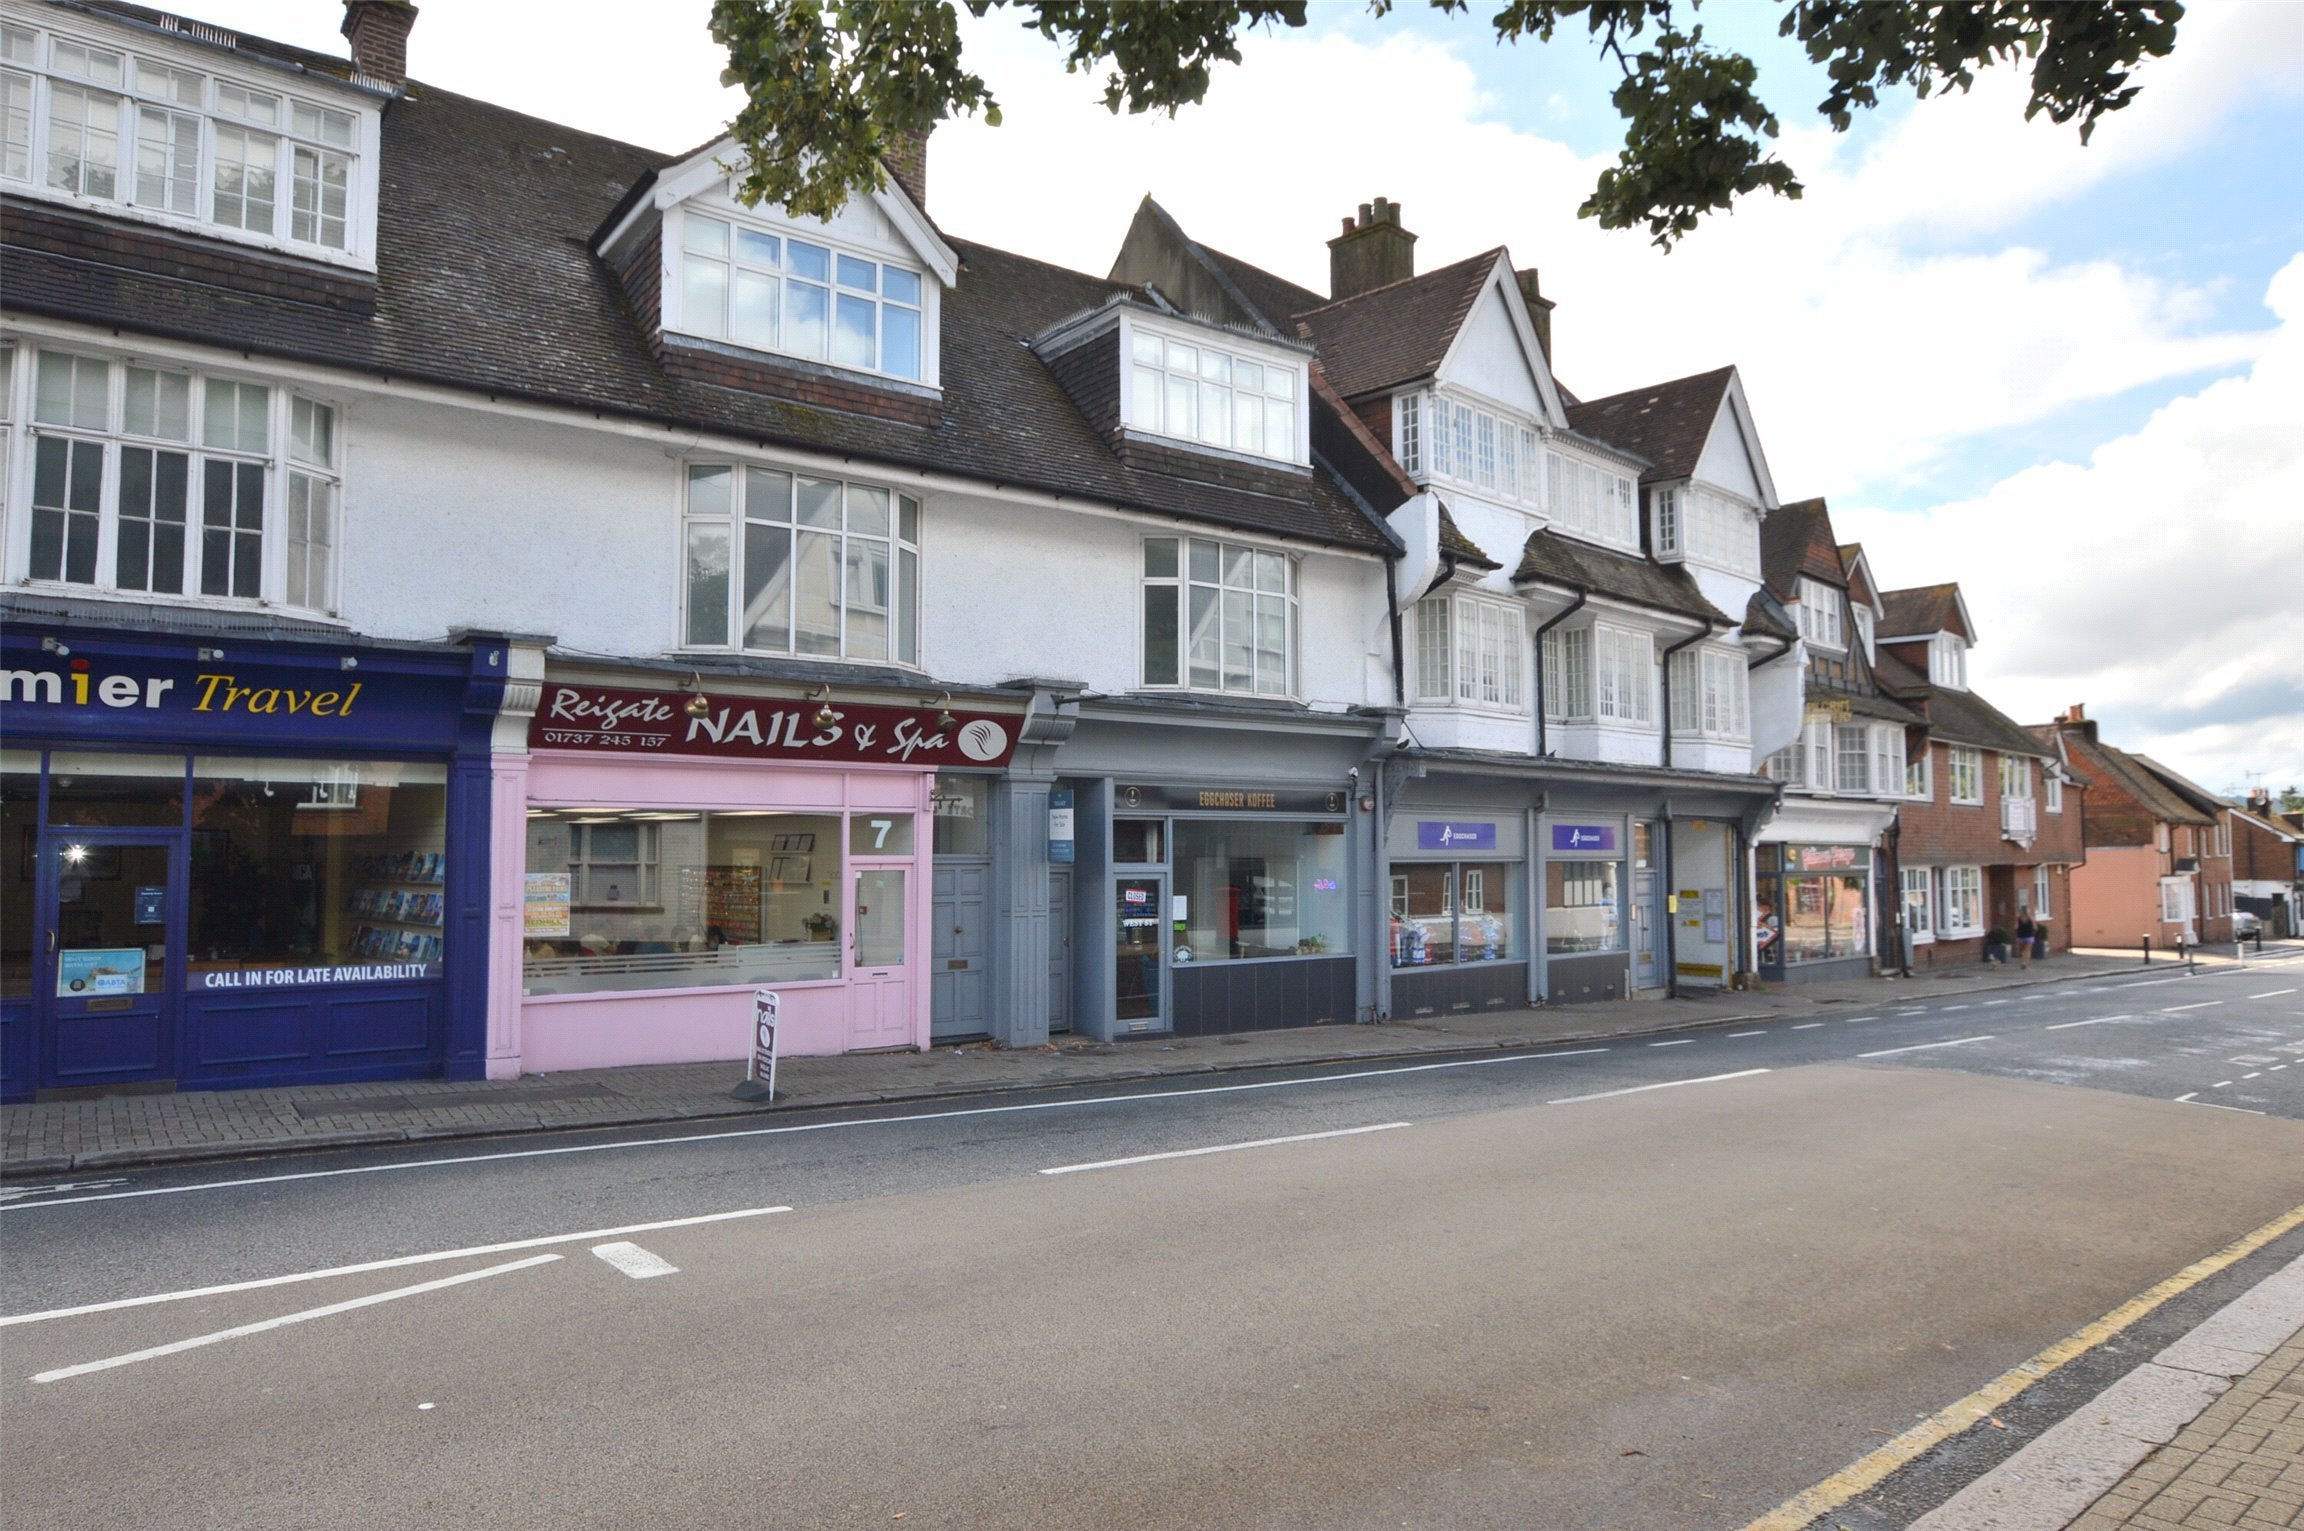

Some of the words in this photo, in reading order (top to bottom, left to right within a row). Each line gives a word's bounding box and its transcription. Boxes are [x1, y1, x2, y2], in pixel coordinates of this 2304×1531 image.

[192, 674, 362, 717] Travel
[550, 688, 674, 730] Reigate
[545, 732, 593, 744] 01737
[601, 735, 631, 746] 245
[640, 737, 666, 748] 157
[685, 707, 845, 748] NAILS
[854, 724, 876, 751] &
[887, 717, 949, 761] Spa
[1199, 791, 1244, 807] EGGCHASER
[1247, 793, 1276, 808] KOFFEE
[871, 820, 892, 848] 7
[1127, 892, 1145, 900] CLOSED
[205, 972, 242, 987] CALL
[245, 971, 262, 986] IN
[266, 970, 294, 985] FOR
[298, 967, 331, 983] LATE
[333, 963, 427, 981] AVAILABILITY
